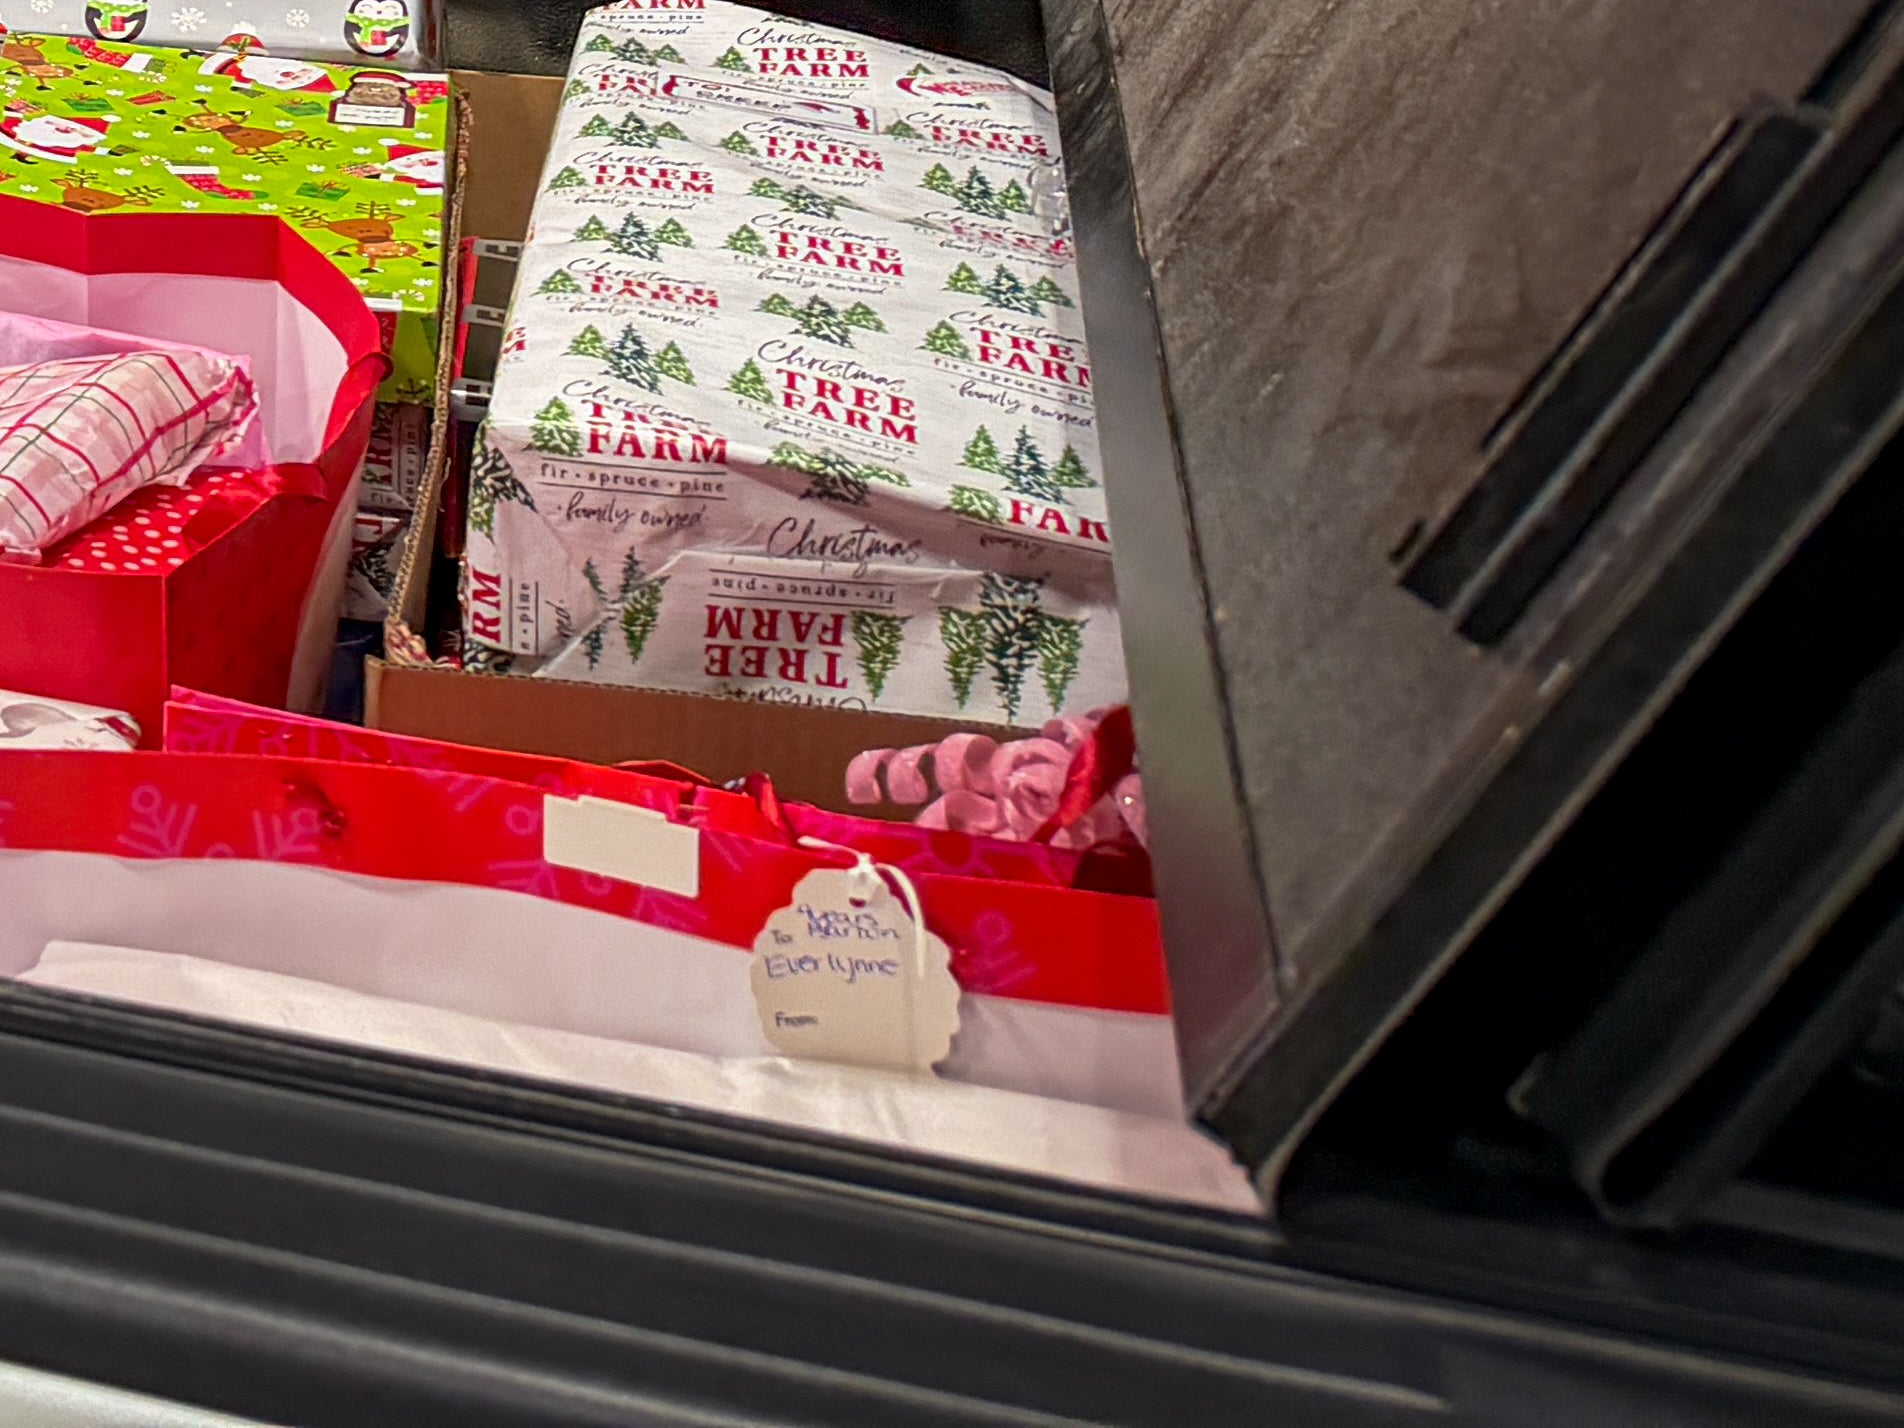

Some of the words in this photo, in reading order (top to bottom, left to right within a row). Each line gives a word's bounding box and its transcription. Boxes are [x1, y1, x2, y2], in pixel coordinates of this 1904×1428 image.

[753, 46, 869, 63] TREE
[758, 62, 870, 78] FARM
[760, 135, 881, 160] TREE
[767, 147, 884, 173] FARM
[589, 164, 714, 183] TREE
[594, 175, 715, 194] FARM
[769, 230, 901, 262] TREE
[776, 244, 905, 277] FARM
[591, 283, 720, 309] FARM
[970, 326, 1075, 363] TRE
[757, 339, 907, 393] Christmas
[776, 367, 918, 422] TREE
[958, 380, 1024, 414] family
[782, 393, 920, 445] FARM
[587, 421, 730, 466] FARM
[542, 461, 568, 479] fir
[588, 469, 660, 491] spruce
[679, 477, 726, 494] pine
[564, 491, 634, 527] family
[640, 503, 707, 529] owned
[765, 516, 924, 577] Christmas
[710, 575, 758, 592] pine
[775, 580, 844, 601] spruce
[704, 604, 845, 647] FARM
[704, 643, 850, 690] TREE
